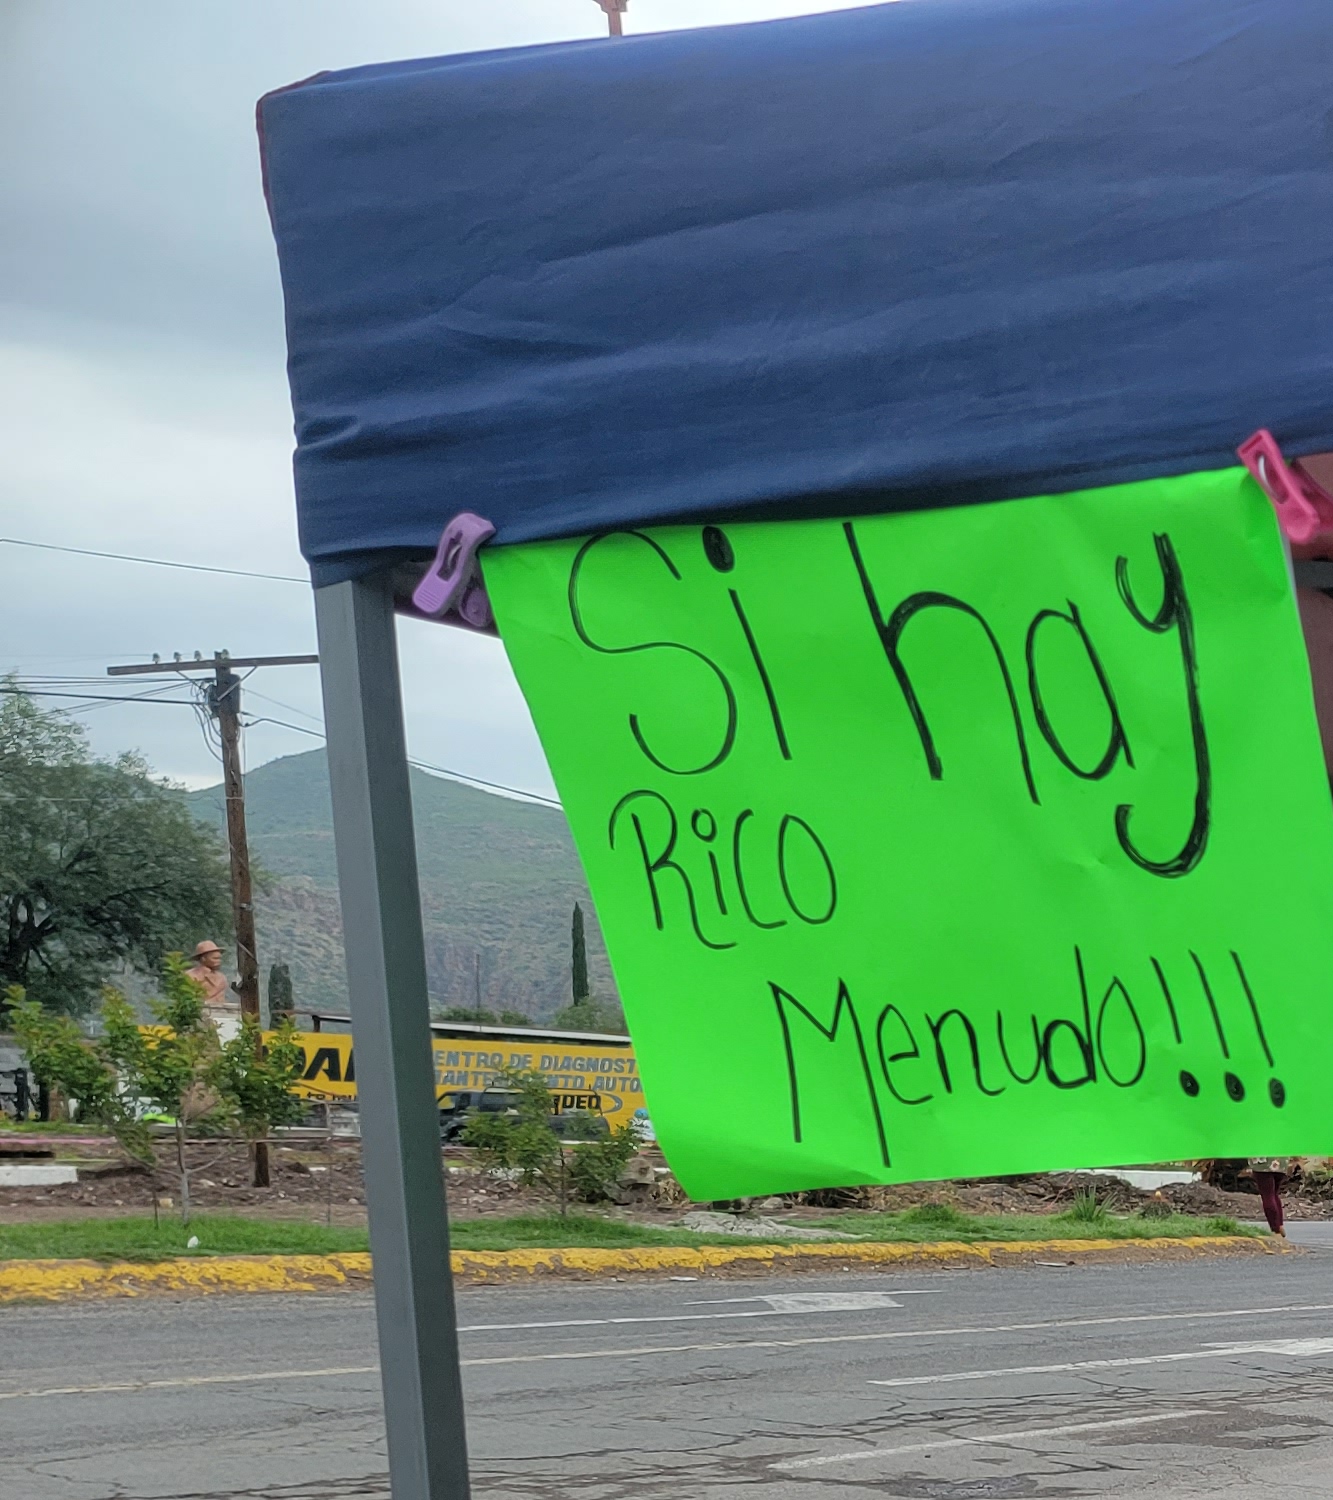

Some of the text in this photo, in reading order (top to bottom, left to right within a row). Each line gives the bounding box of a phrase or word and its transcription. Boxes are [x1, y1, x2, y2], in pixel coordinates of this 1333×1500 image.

[569, 522, 1211, 878] Si hay
[510, 1053, 533, 1068] DE
[592, 1075, 643, 1093] AUTO
[768, 945, 1286, 1169] Menudo!!!
